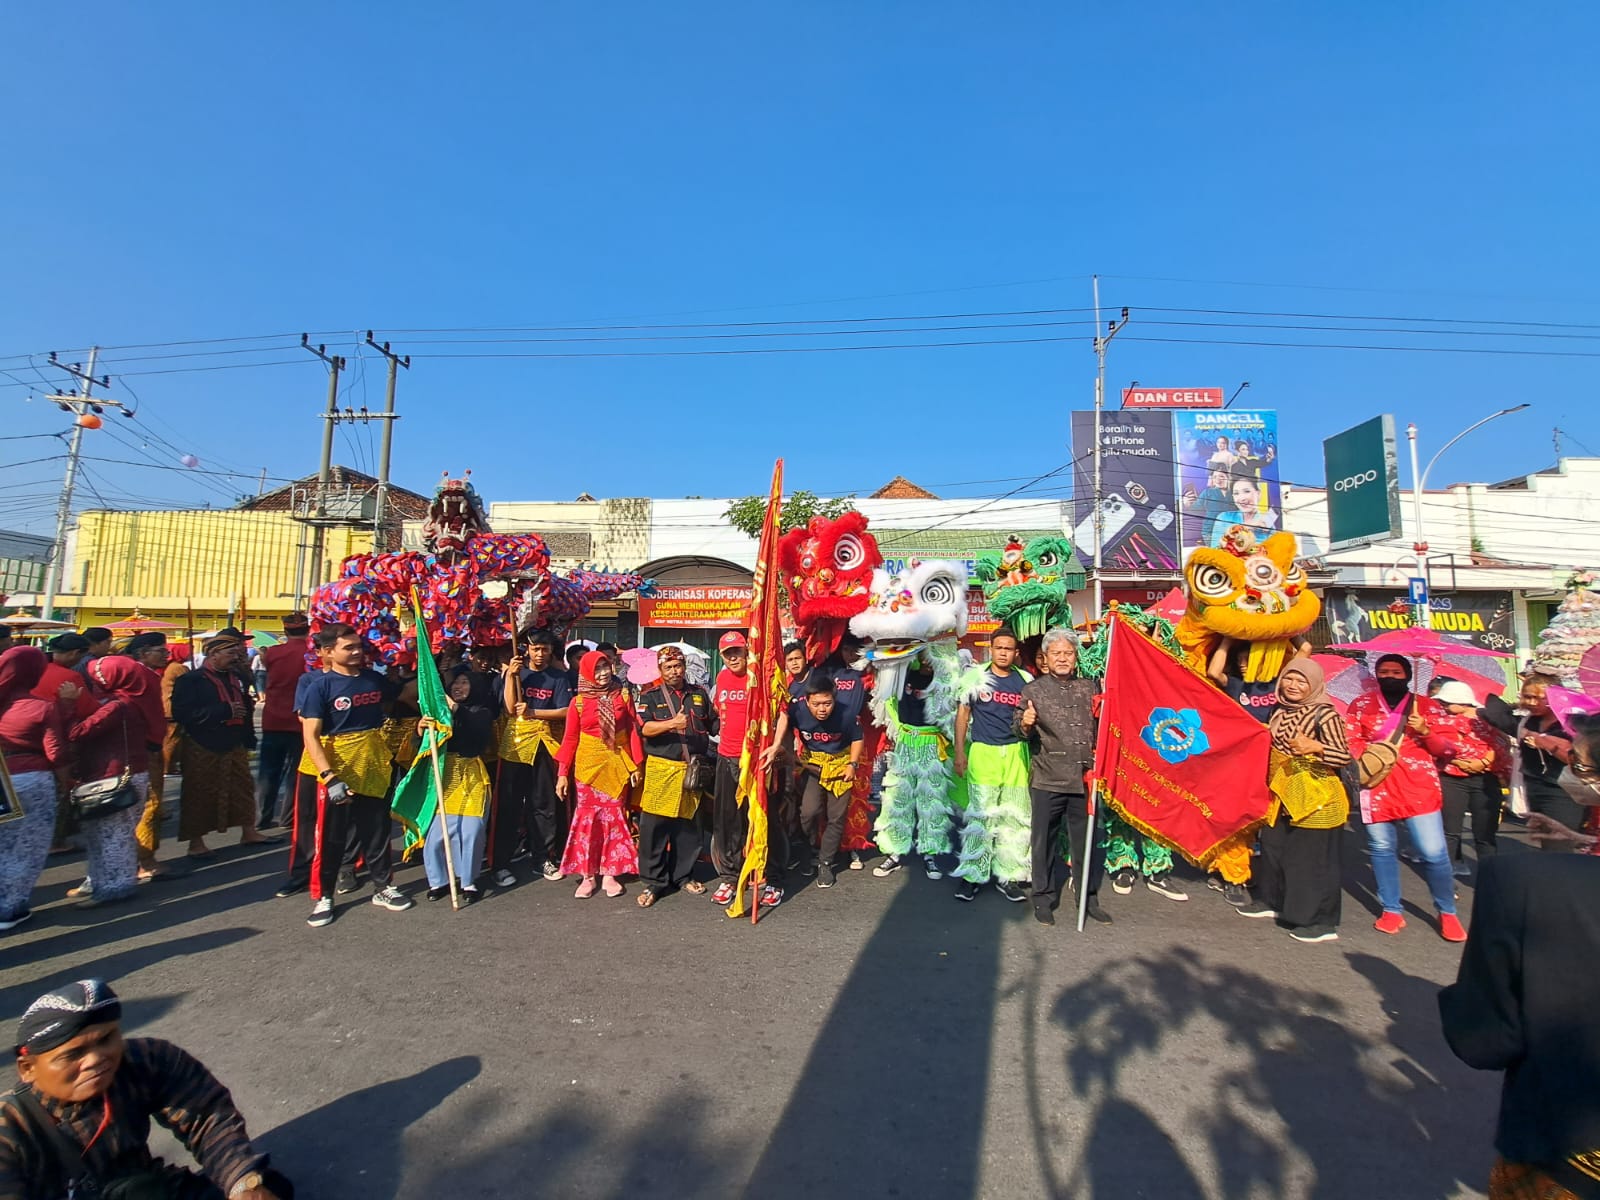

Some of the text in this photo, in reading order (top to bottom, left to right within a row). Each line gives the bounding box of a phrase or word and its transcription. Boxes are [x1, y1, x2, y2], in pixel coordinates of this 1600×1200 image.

[1134, 393, 1213, 403] DAN CELL
[1111, 436, 1145, 445] iPhone
[1334, 469, 1377, 492] oppo
[1412, 582, 1424, 600] P
[1430, 612, 1485, 631] MUDA
